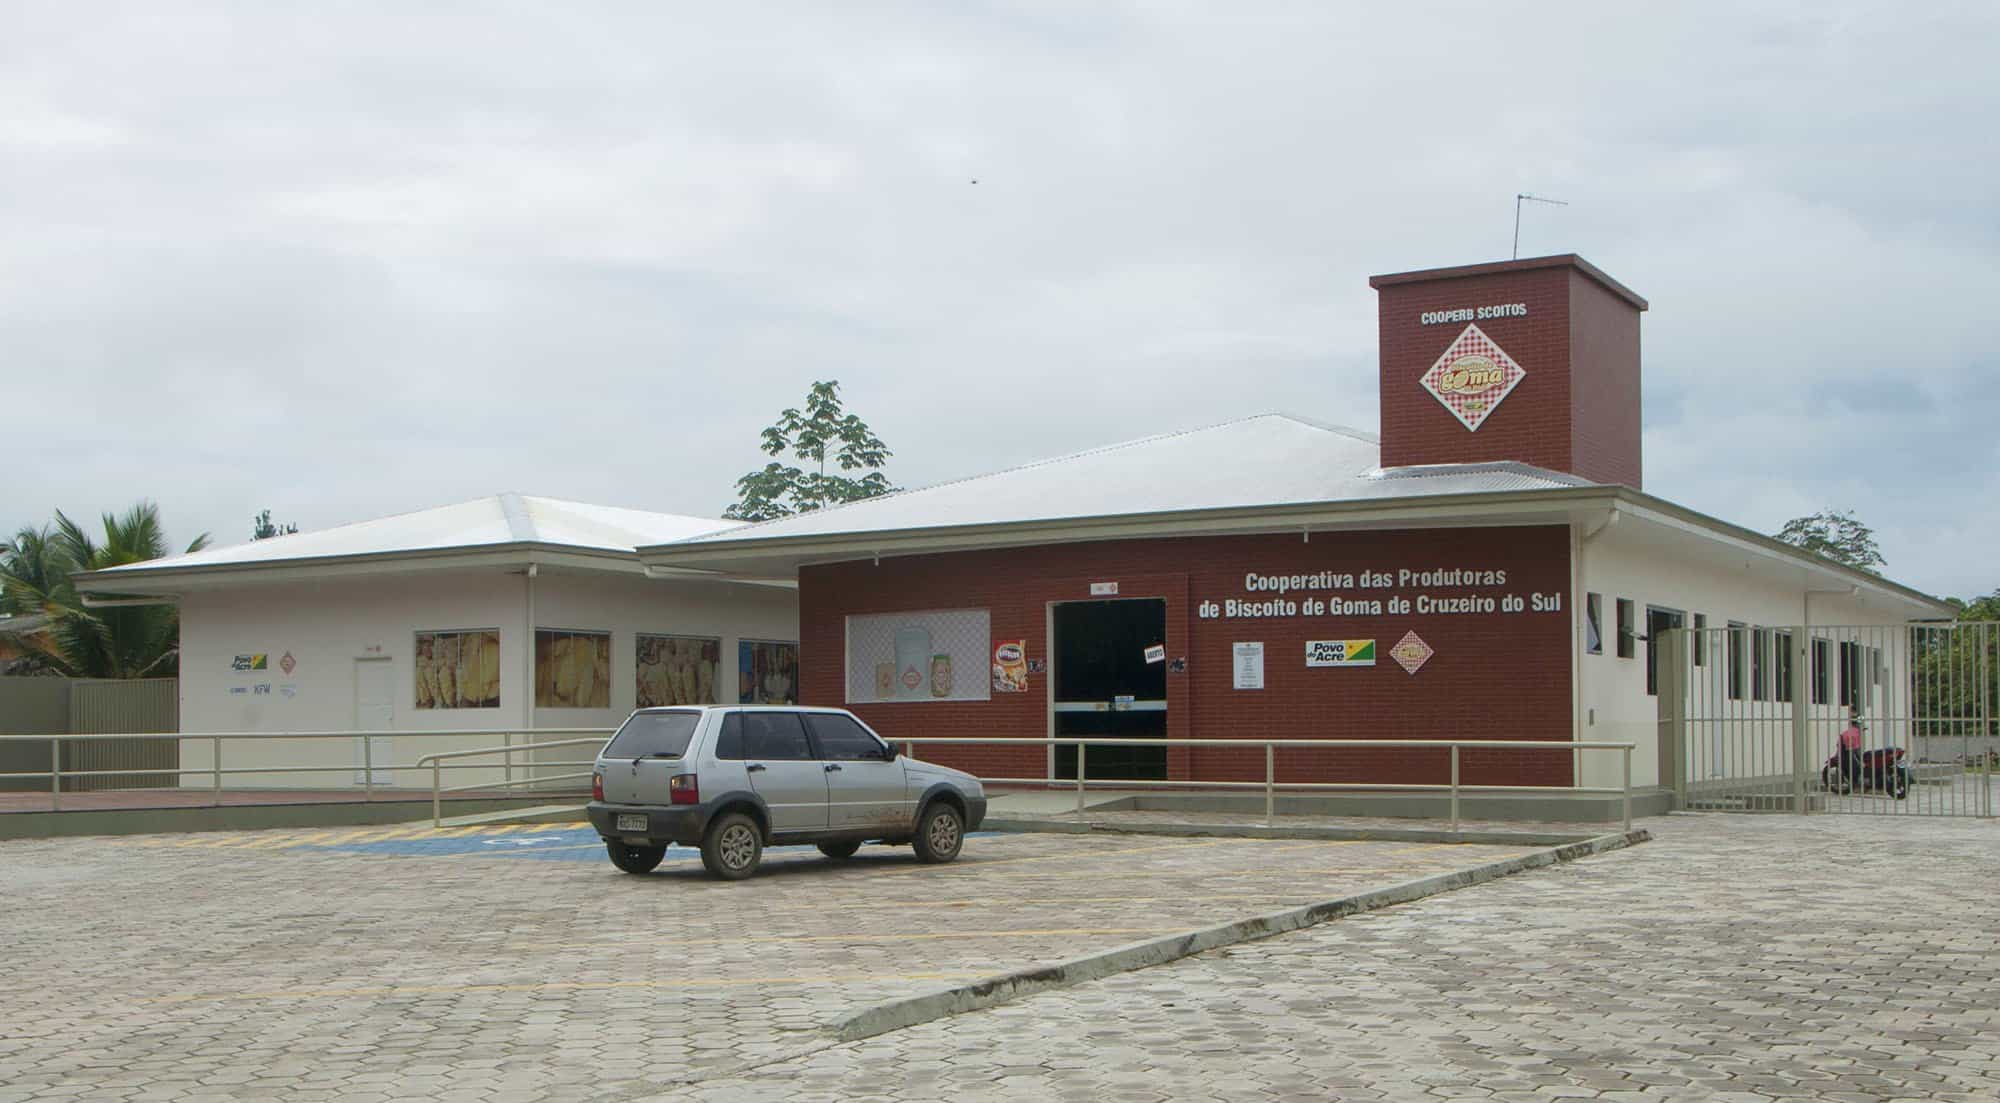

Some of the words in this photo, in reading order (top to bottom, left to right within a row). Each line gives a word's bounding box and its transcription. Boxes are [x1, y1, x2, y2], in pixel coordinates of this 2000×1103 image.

[1245, 571, 1353, 594] Cooperativa
[1359, 570, 1393, 588] das
[1399, 568, 1507, 587] Produtoras
[1199, 600, 1220, 618] de
[1225, 598, 1297, 617] Biscoito
[1302, 597, 1325, 616] de
[1330, 597, 1382, 616] Goma
[1388, 596, 1411, 614] de
[1416, 594, 1496, 614] Cruzeiro
[1501, 594, 1524, 612] do
[1531, 592, 1561, 611] Sul
[1314, 643, 1344, 652] Povo
[1315, 651, 1345, 661] Acre
